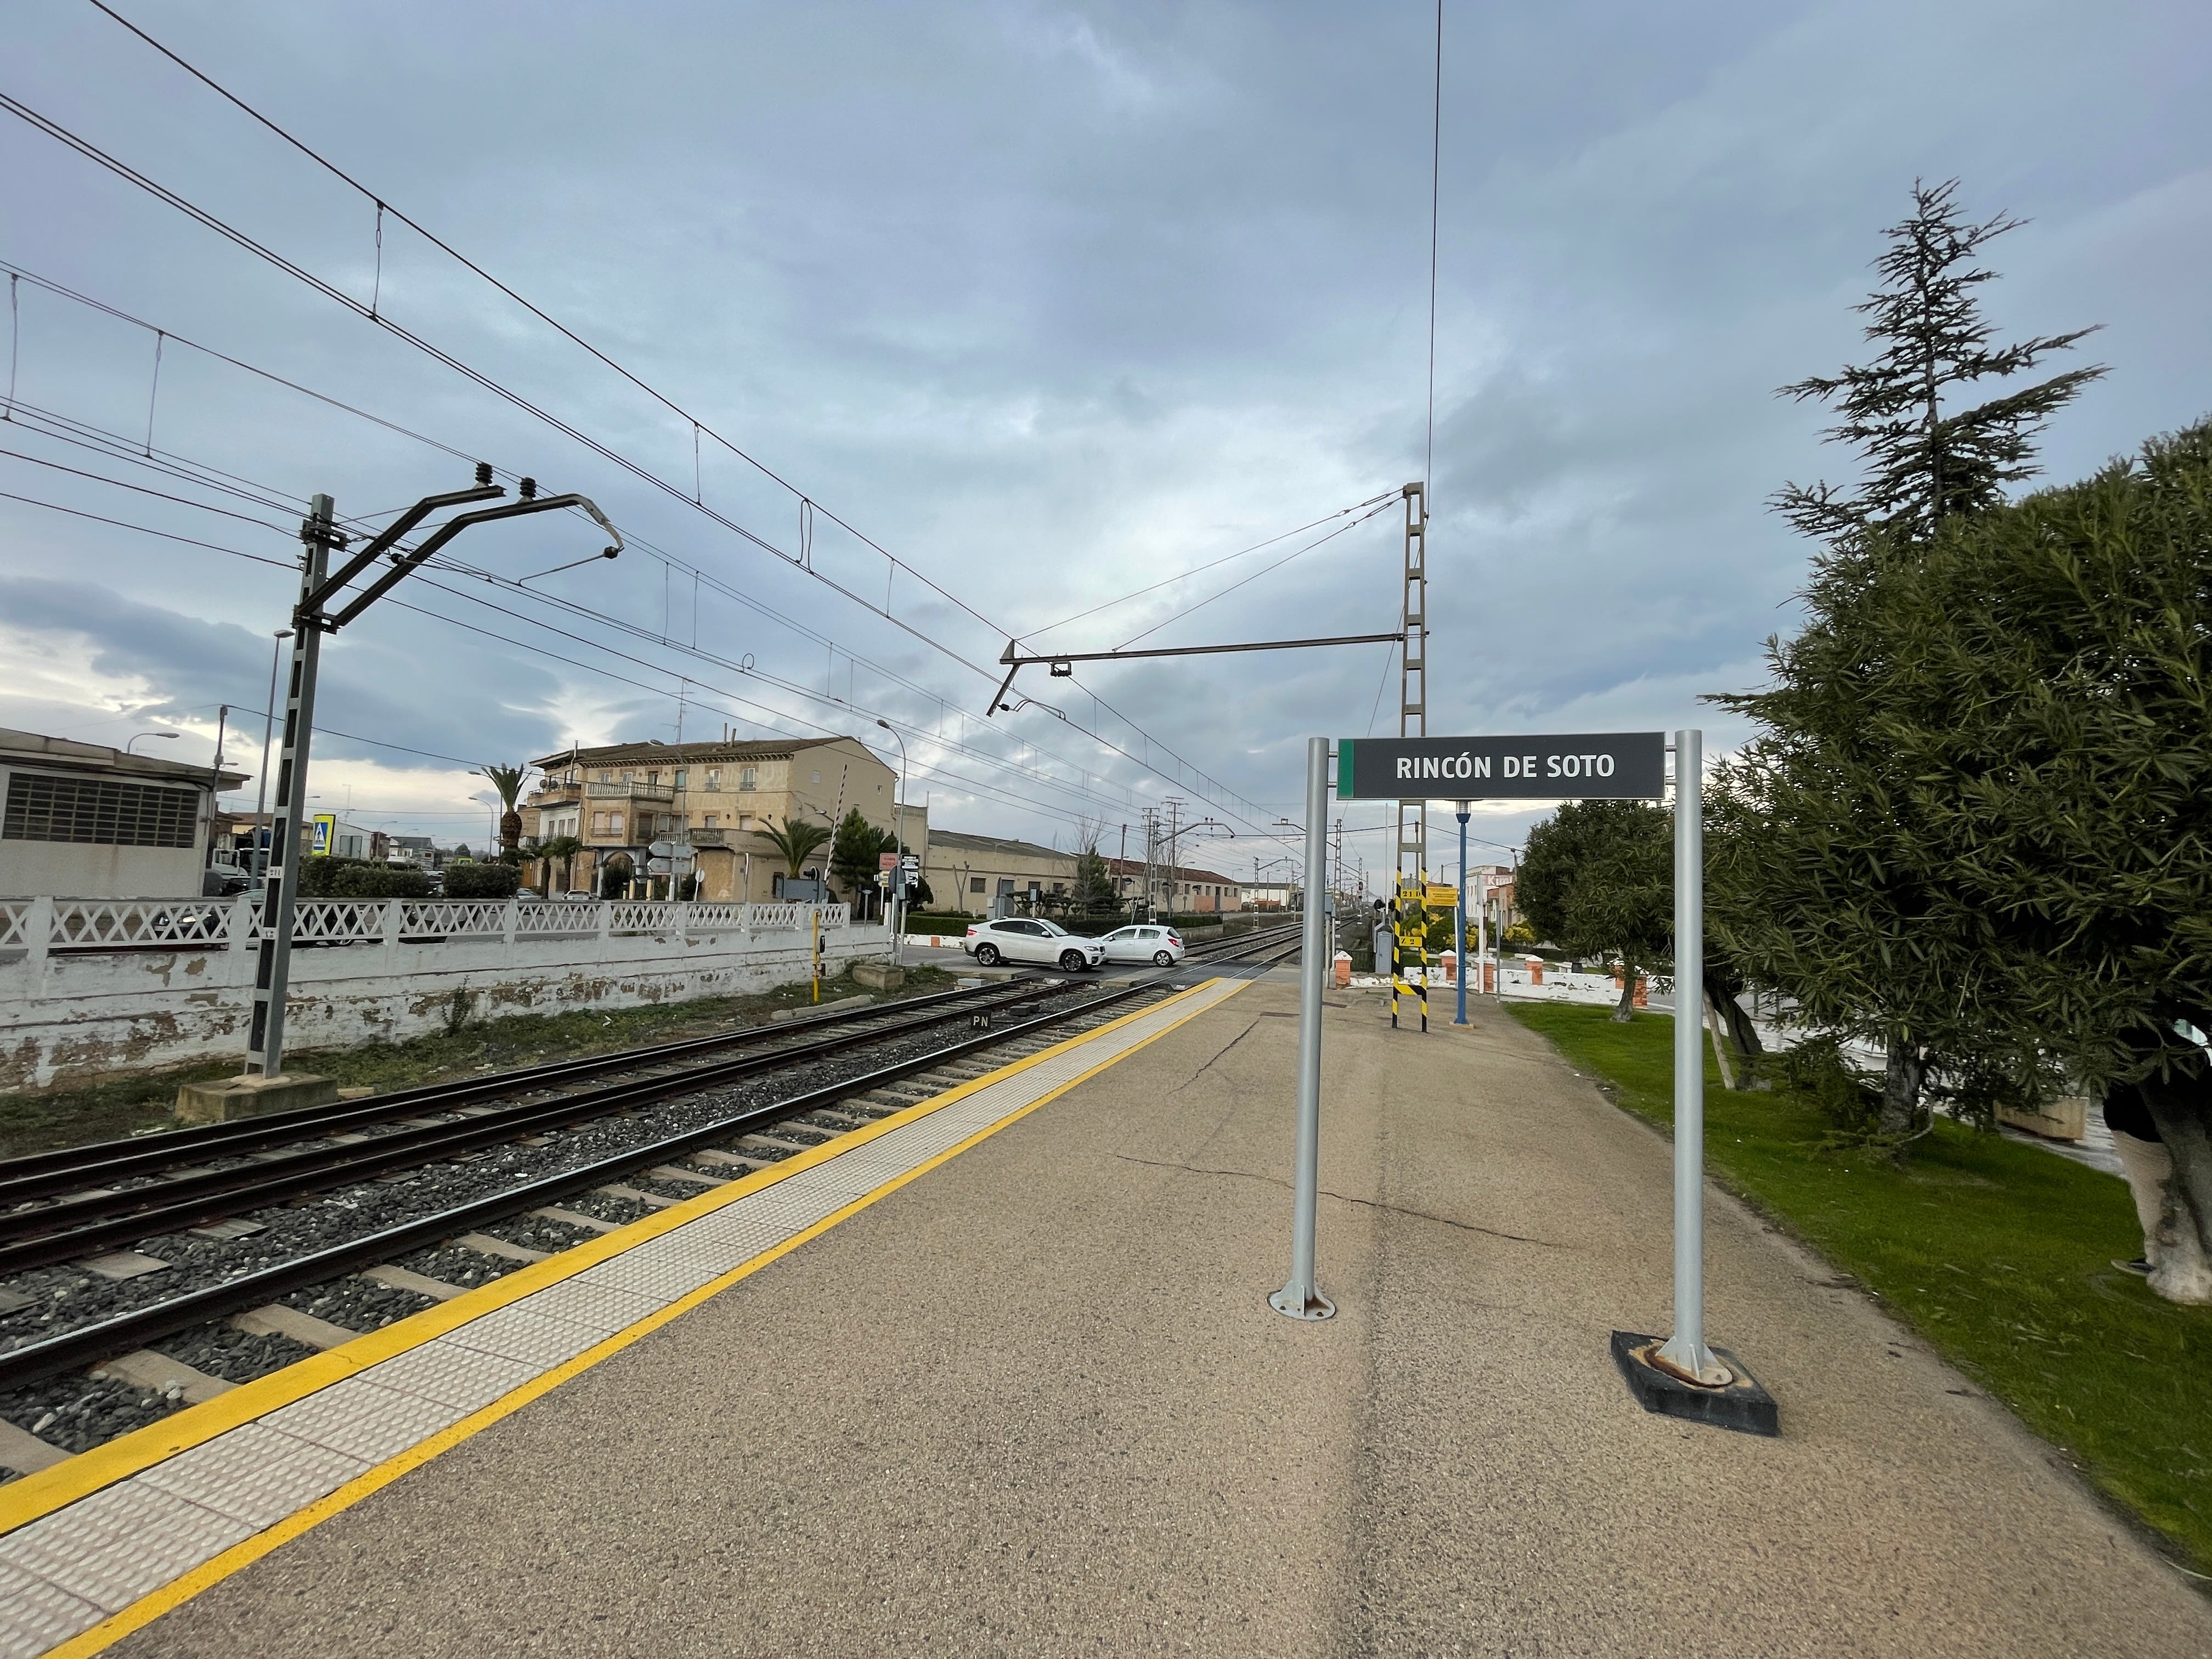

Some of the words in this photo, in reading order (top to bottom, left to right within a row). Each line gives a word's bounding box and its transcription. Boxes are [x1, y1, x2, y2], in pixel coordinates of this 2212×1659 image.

[1396, 751, 1491, 779] RINCÓN
[1504, 755, 1537, 778] DE
[1546, 754, 1615, 778] SOTO
[973, 1015, 988, 1027] PN
